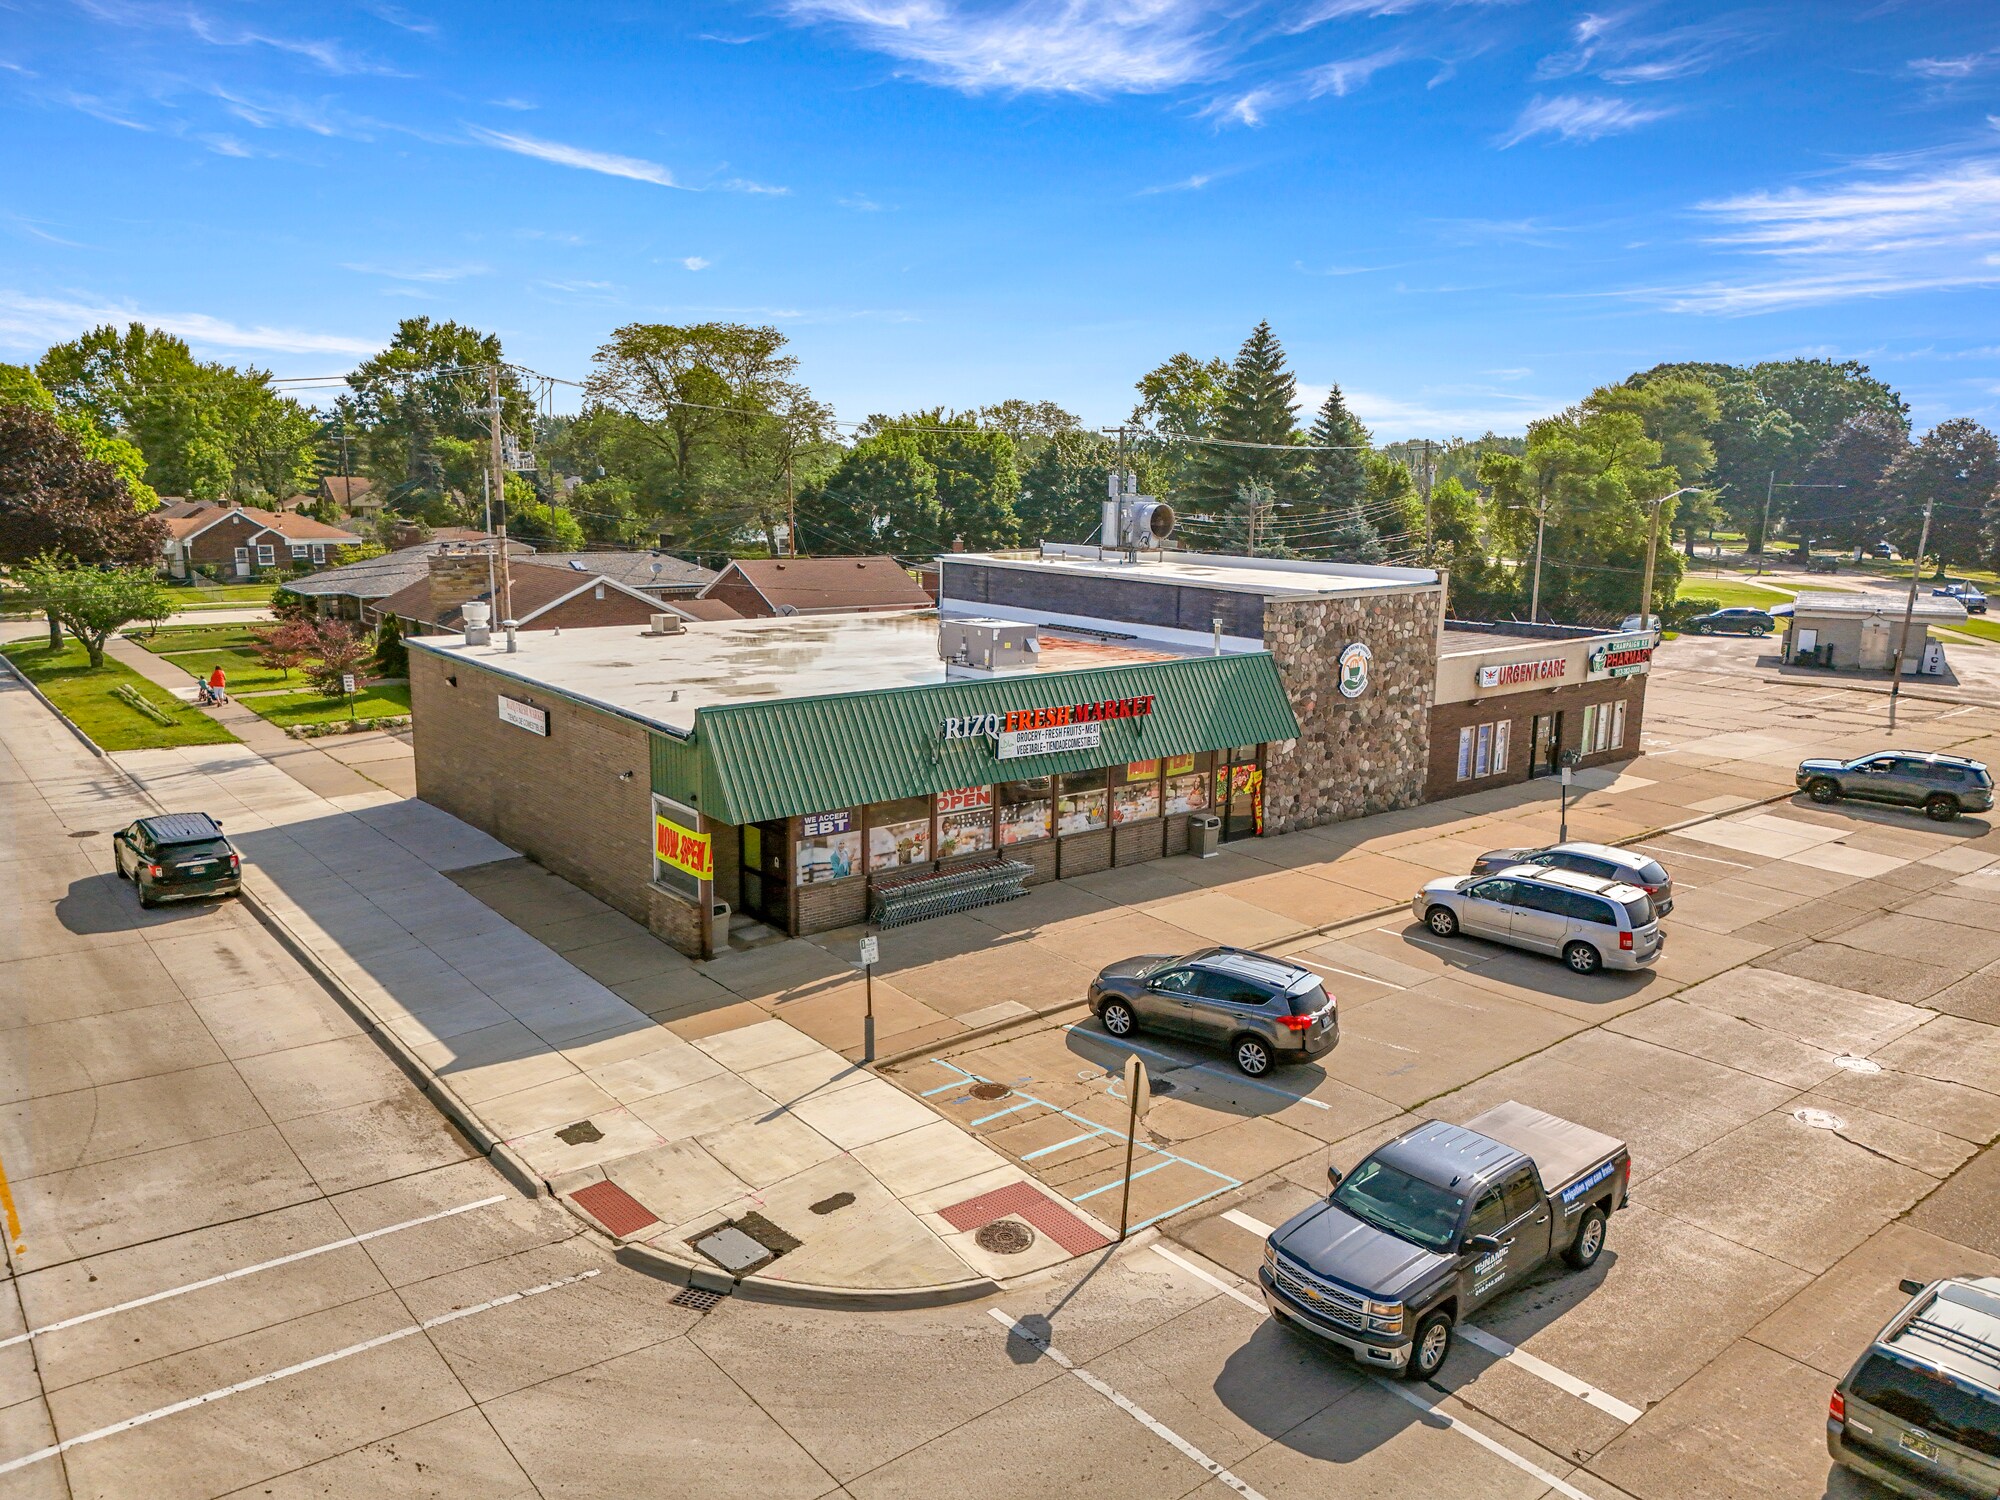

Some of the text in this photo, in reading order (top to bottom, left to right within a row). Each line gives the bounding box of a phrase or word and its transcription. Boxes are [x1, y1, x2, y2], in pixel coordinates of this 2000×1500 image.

[1500, 659, 1566, 685] URGENT CARE
[1929, 647, 1939, 672] ICE
[945, 695, 1155, 740] RIZQ FRESH MARKET
[937, 791, 990, 811] OPEN
[804, 812, 849, 824] WE ACCEPT
[804, 819, 849, 836] EBT
[657, 823, 679, 860] NOW
[680, 835, 707, 873] OPEN
[1584, 1175, 1595, 1192] you
[1593, 1170, 1604, 1184] can
[1474, 1246, 1509, 1274] DYNAMIC
